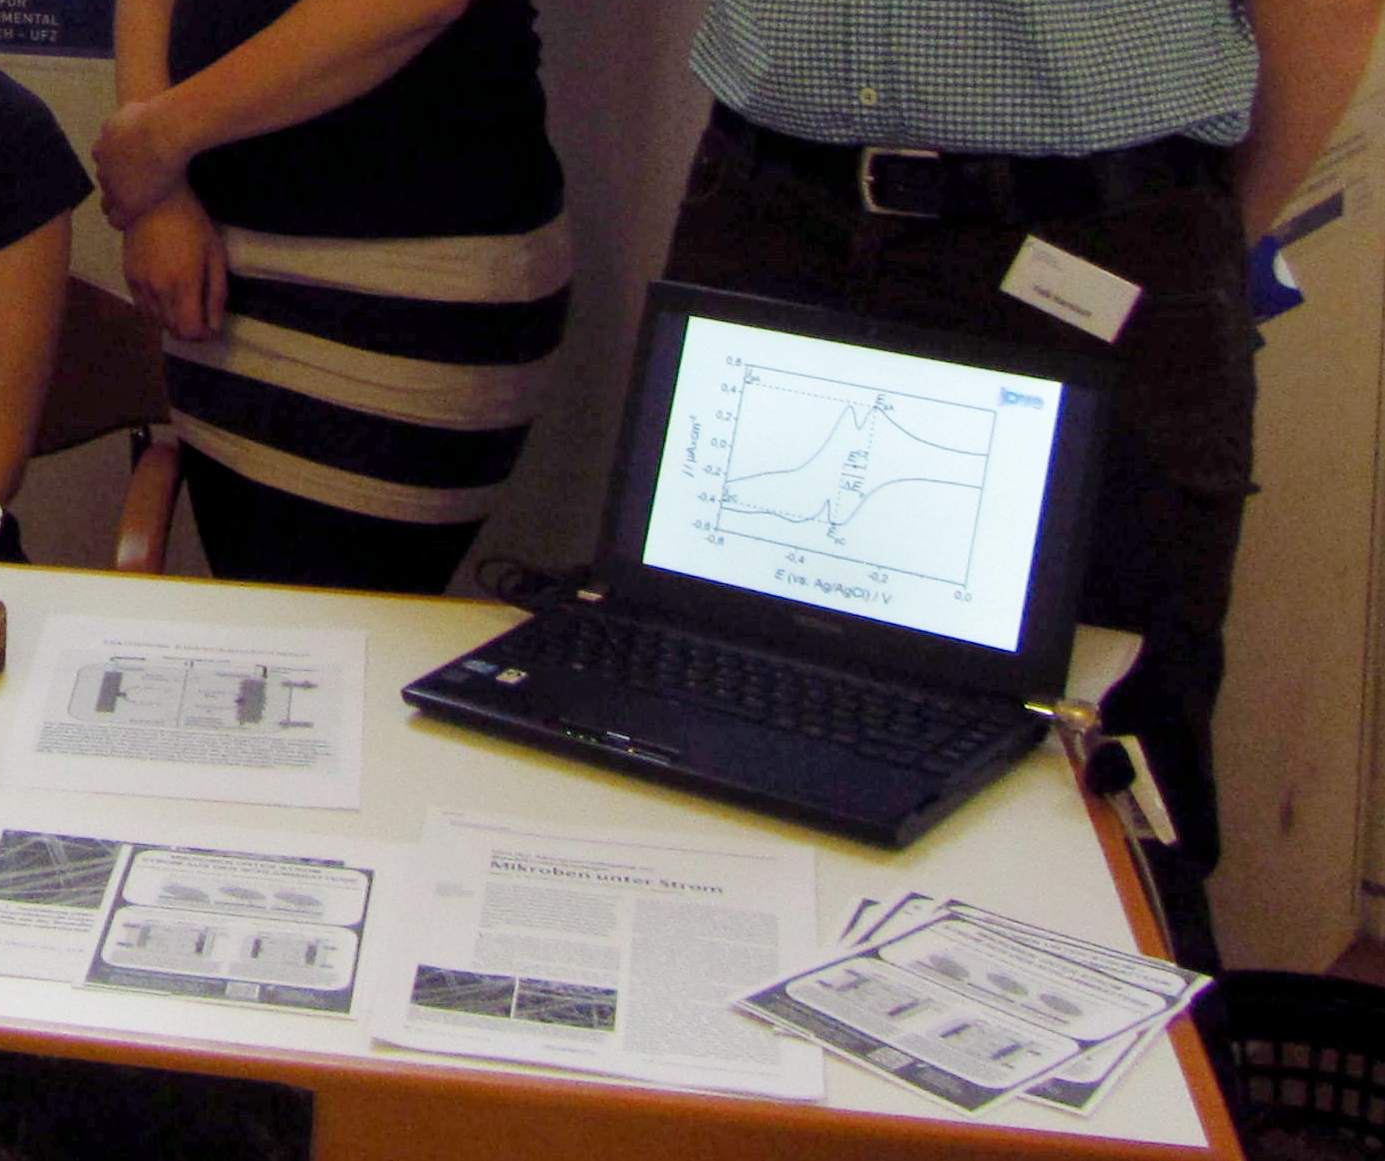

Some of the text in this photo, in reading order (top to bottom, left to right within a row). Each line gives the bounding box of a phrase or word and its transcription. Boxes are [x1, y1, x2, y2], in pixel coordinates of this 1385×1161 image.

[29, 29, 58, 42] UFZ
[785, 552, 805, 565] -0.4
[868, 571, 889, 584] -0.2
[774, 568, 785, 581] E
[881, 592, 892, 605] V
[954, 590, 972, 603] 0.0
[489, 859, 724, 895] Mikroben unter Strom
